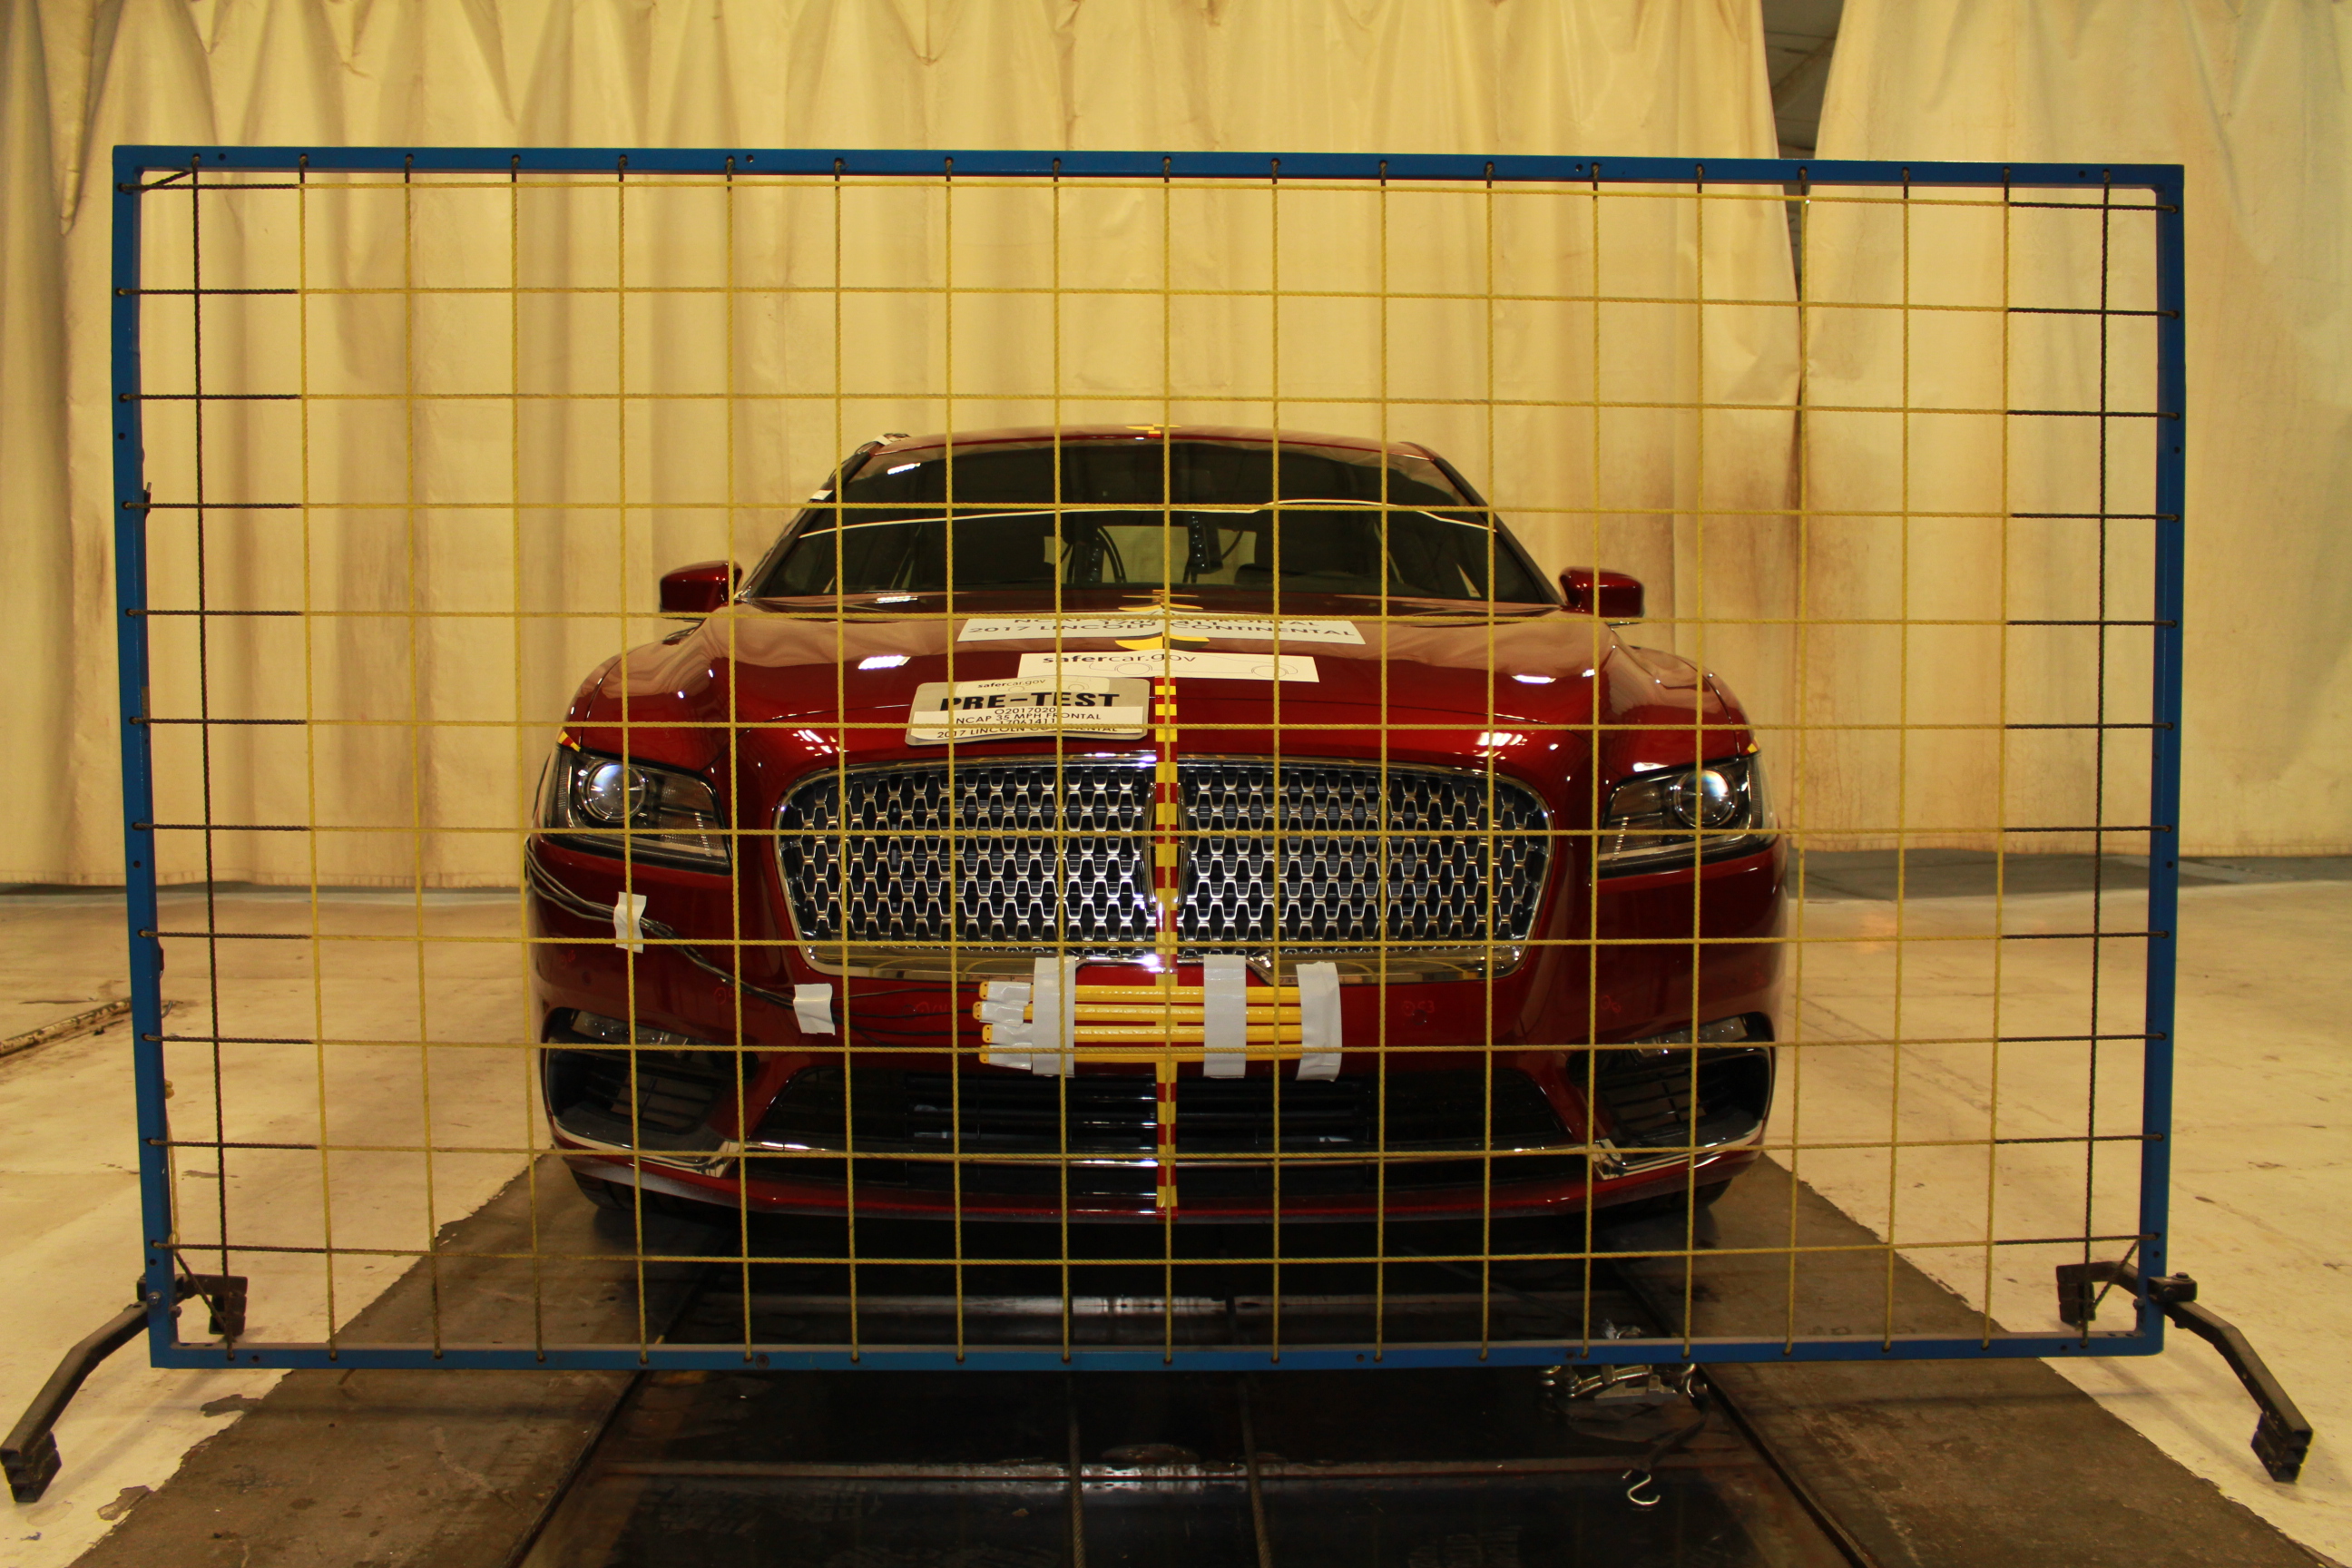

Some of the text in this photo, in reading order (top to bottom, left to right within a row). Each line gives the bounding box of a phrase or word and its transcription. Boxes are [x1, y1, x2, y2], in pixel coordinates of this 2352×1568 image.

[1040, 622, 1156, 631] LINCOLN
[1170, 622, 1355, 636] CONTINENTAL
[1043, 653, 1196, 663] safercar.gov
[977, 679, 1046, 689] safercar.gov
[940, 692, 1120, 710] PRE-TEST
[956, 715, 993, 724] NCAP
[936, 730, 966, 739] 2017
